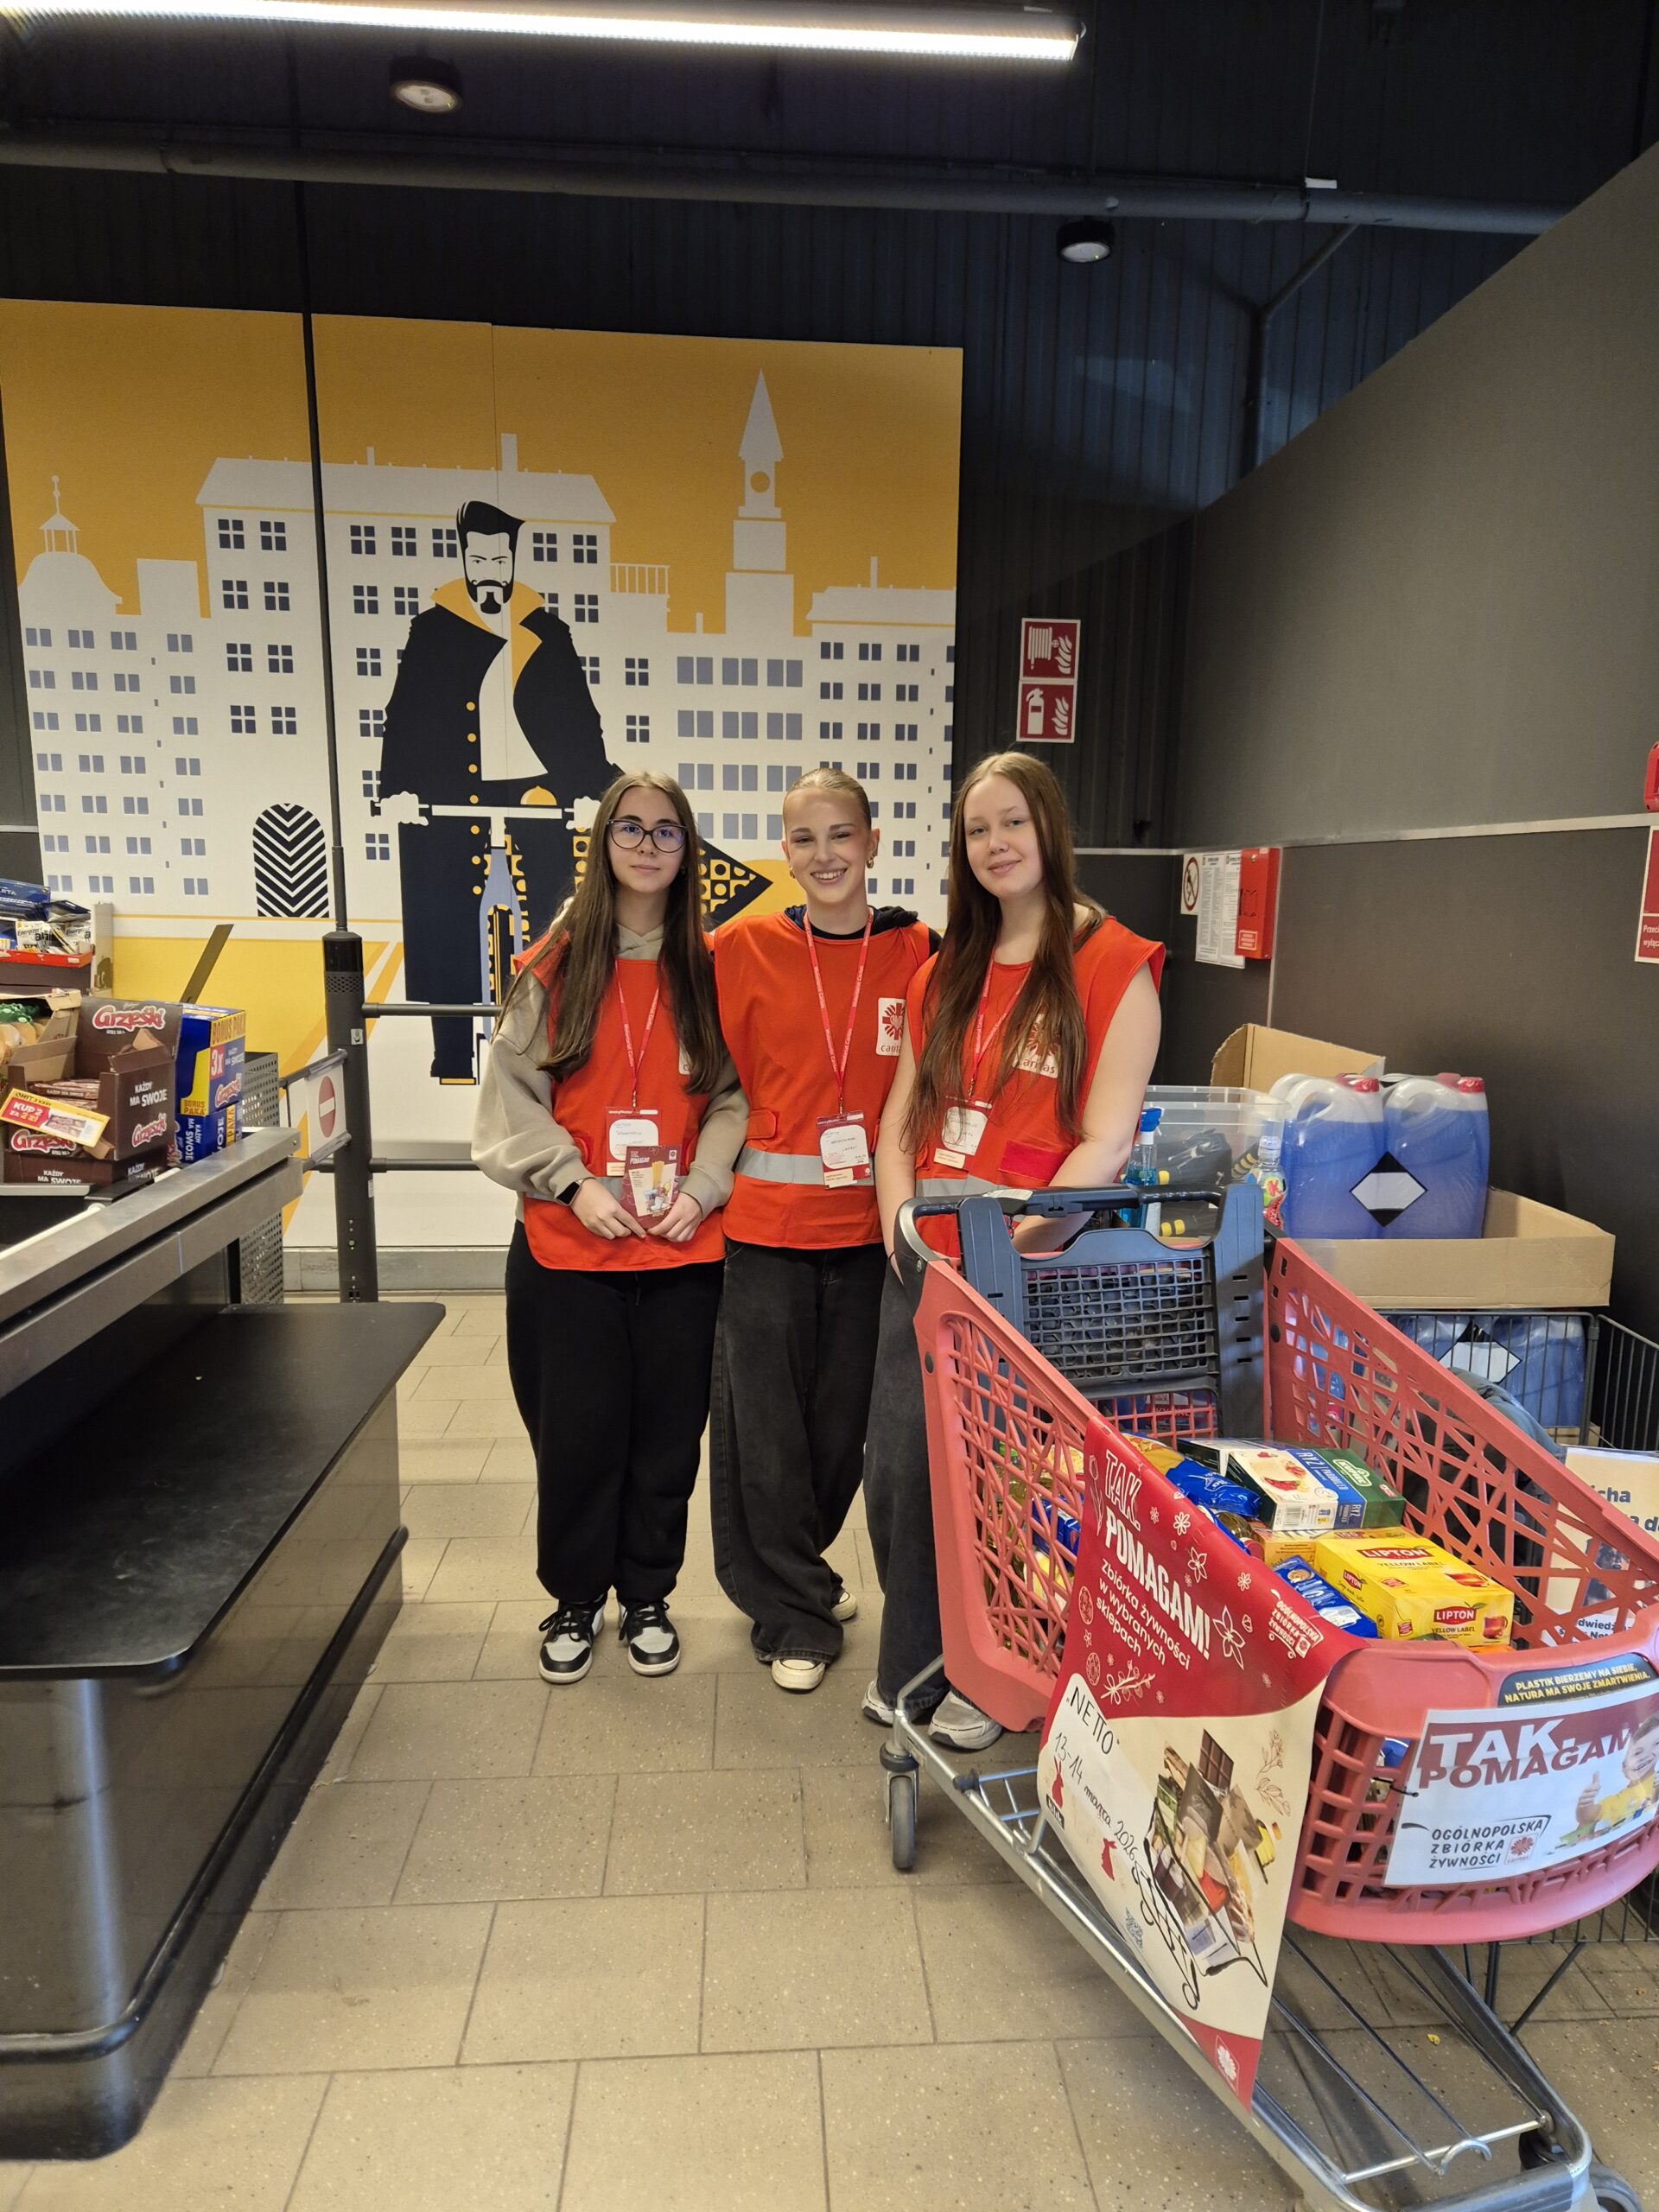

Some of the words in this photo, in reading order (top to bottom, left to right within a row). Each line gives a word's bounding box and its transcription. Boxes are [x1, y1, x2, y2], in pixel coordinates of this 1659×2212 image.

[1643, 925, 1659, 934] Przeci
[880, 1043, 900, 1053] carit
[211, 1049, 224, 1076] 3x
[1018, 1056, 1055, 1074] arias
[130, 1096, 140, 1107] MA
[141, 1090, 168, 1107] SWOJE
[135, 1081, 152, 1093] KAŻDY
[13, 1102, 35, 1113] KUP
[35, 1108, 43, 1116] 2
[188, 1118, 194, 1128] MA
[185, 1131, 194, 1161] SWOJE
[1106, 1449, 1141, 1532] TAK.
[1362, 1548, 1427, 1557] LIPTON
[1105, 1505, 1210, 1660] POMAGAM!
[1344, 1571, 1361, 1589] LIPTON
[1096, 1598, 1142, 1657] sklepach
[1098, 1578, 1109, 1596] w
[1109, 1591, 1166, 1665] wybranych
[1102, 1558, 1139, 1610] Zbiórka
[1140, 1604, 1191, 1670] żywności
[1272, 1608, 1300, 1638] ZBIÓRKA
[1276, 1600, 1319, 1642] OGÓLNOPOLSKA
[1436, 1610, 1474, 1620] LIPTON
[1268, 1617, 1295, 1647] ŻYWNOŚCI
[1504, 1689, 1545, 1703] NATURA
[1546, 1686, 1561, 1697] MA
[1562, 1683, 1591, 1694] SWOJE
[1592, 1671, 1651, 1688] ZMARTWIENIA.
[1515, 1677, 1554, 1692] PLASTIK
[1554, 1669, 1598, 1685] BIERZEMY
[1598, 1667, 1611, 1678] NA
[1611, 1662, 1638, 1675] SIEBIE,
[1429, 1718, 1575, 1769] TAK.
[1055, 1732, 1084, 1785] 13-14
[1084, 1785, 1111, 1828] marca
[1114, 1820, 1139, 1863] 2026
[1432, 1819, 1543, 1840] OGÓLNOPOLSKA
[1431, 1838, 1504, 1854] ZBIÓRKA
[1429, 1853, 1501, 1869] ŻYWNOŚCI
